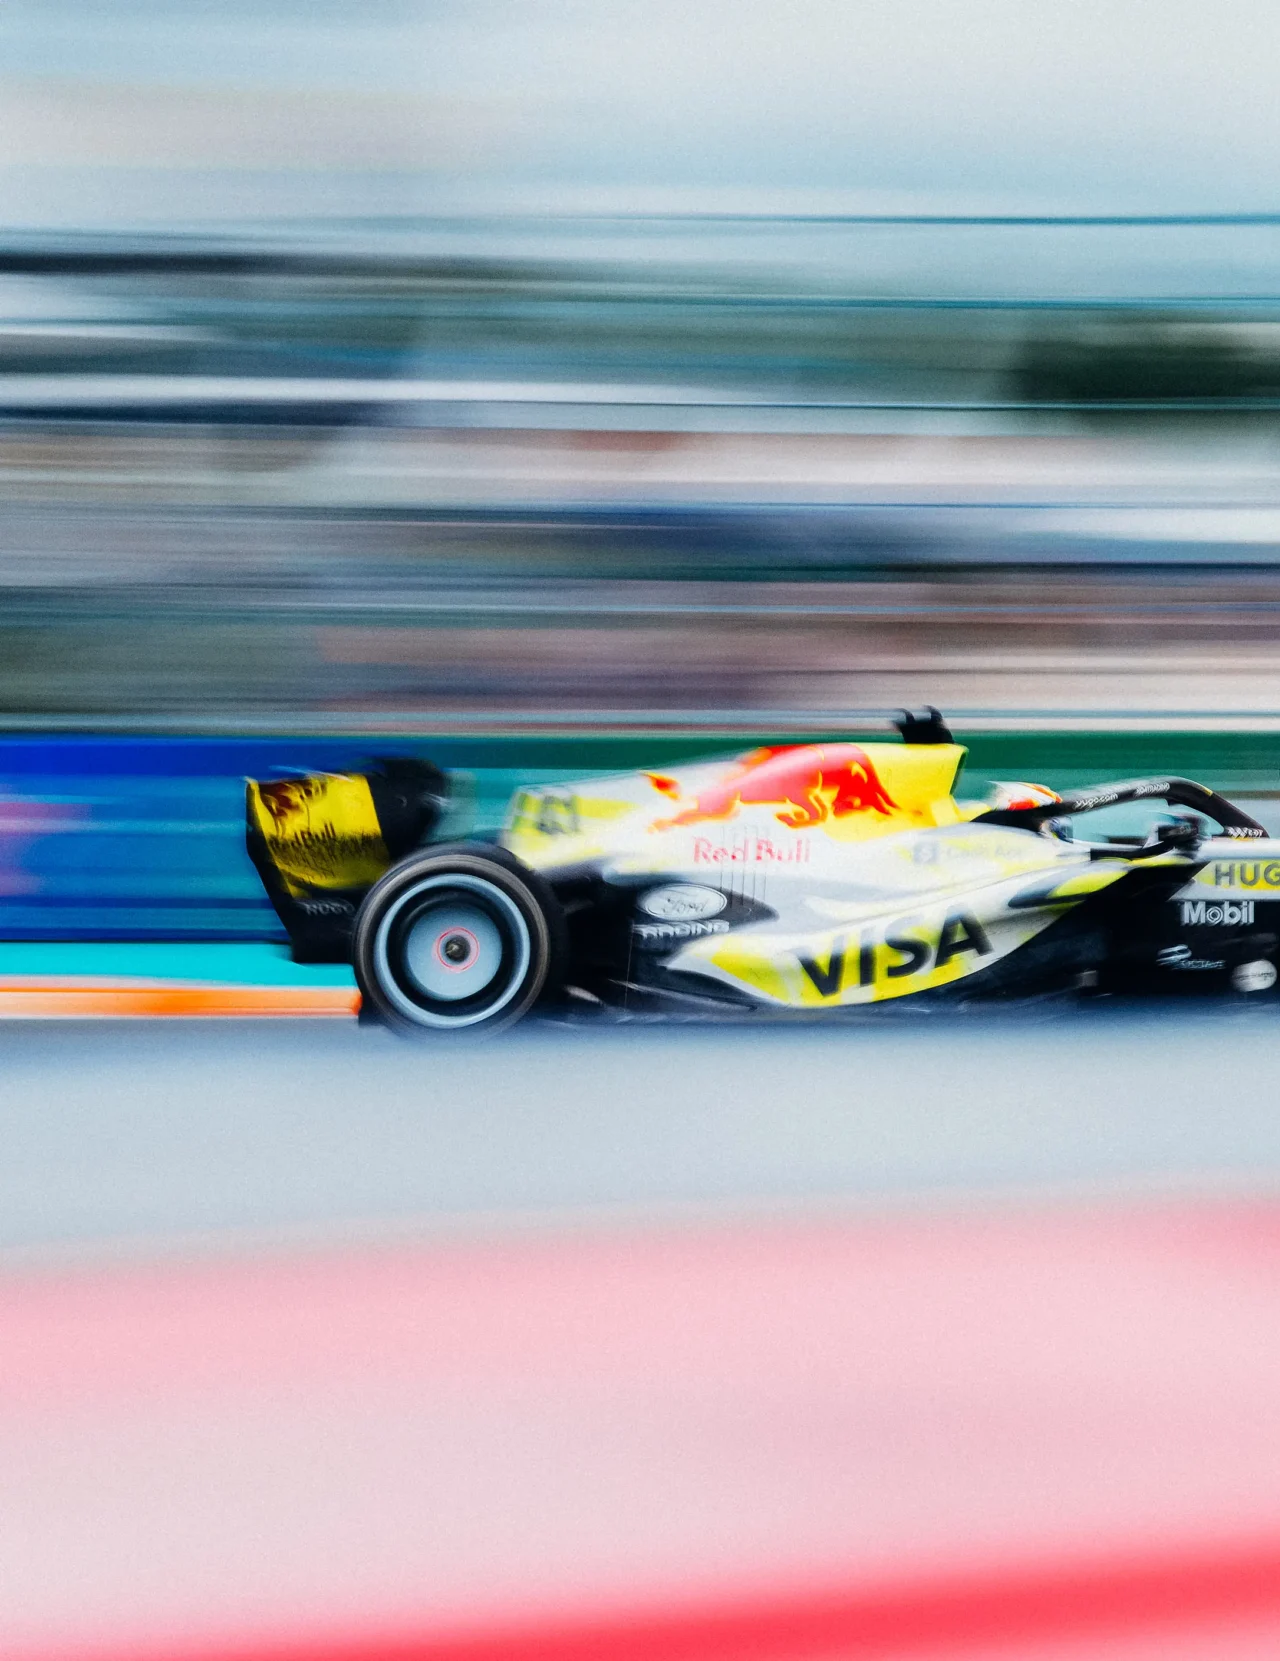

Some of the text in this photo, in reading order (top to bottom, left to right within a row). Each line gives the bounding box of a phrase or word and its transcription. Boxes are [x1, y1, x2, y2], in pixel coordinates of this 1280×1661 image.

[694, 837, 811, 863] Red Bull
[1182, 900, 1255, 925] Mobil
[797, 905, 993, 998] VISA
